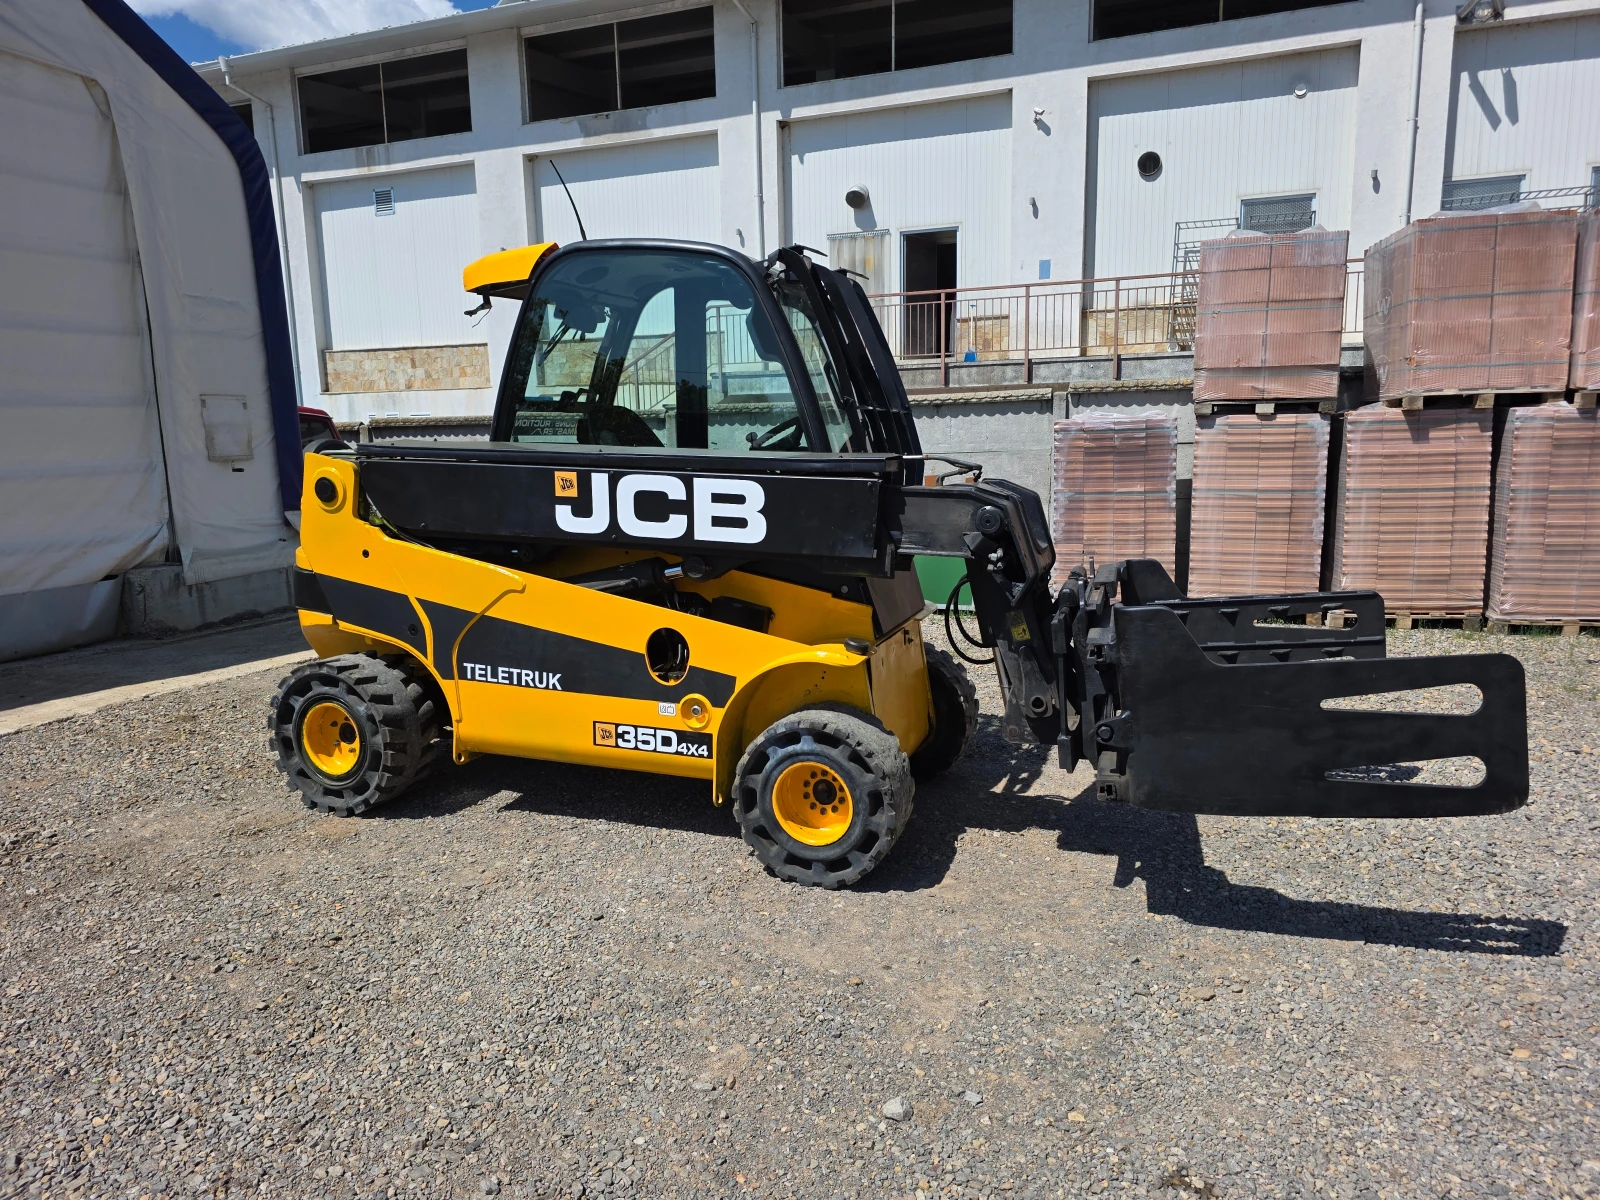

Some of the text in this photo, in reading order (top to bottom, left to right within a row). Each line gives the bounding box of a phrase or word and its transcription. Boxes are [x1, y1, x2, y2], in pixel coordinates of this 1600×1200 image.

[559, 477, 575, 491] JCB
[555, 472, 767, 544] JCB
[463, 663, 562, 690] TELETRUK
[617, 725, 678, 753] 35D
[677, 742, 709, 757] 4X4
